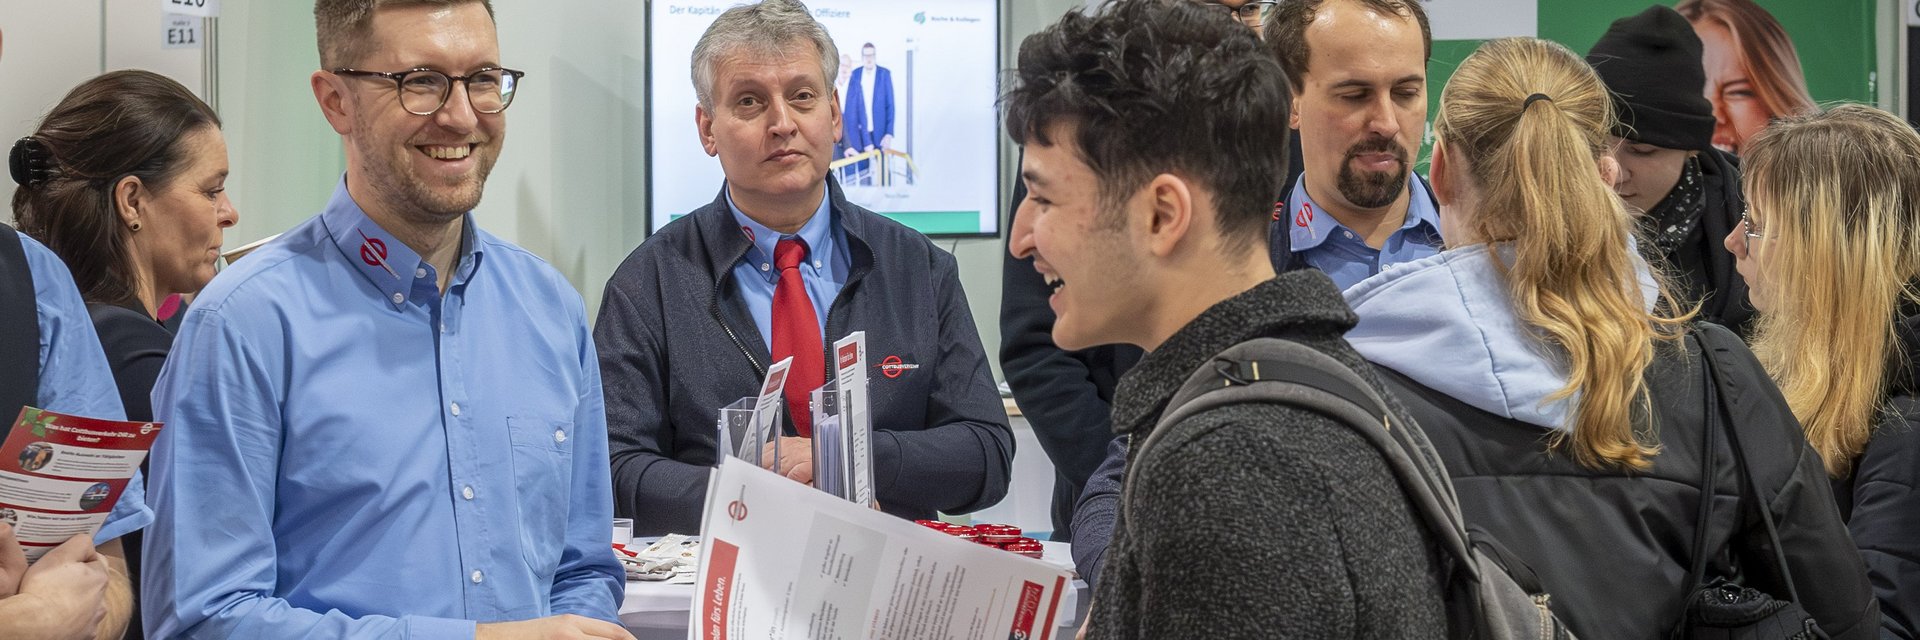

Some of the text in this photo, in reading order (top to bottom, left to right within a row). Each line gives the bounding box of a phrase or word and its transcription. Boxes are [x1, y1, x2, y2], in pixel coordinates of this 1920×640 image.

[669, 5, 721, 16] Der Kapitän
[815, 8, 850, 18] Offiziere
[168, 28, 195, 44] E11
[712, 576, 727, 607] Leben.
[710, 605, 722, 625] fürs
